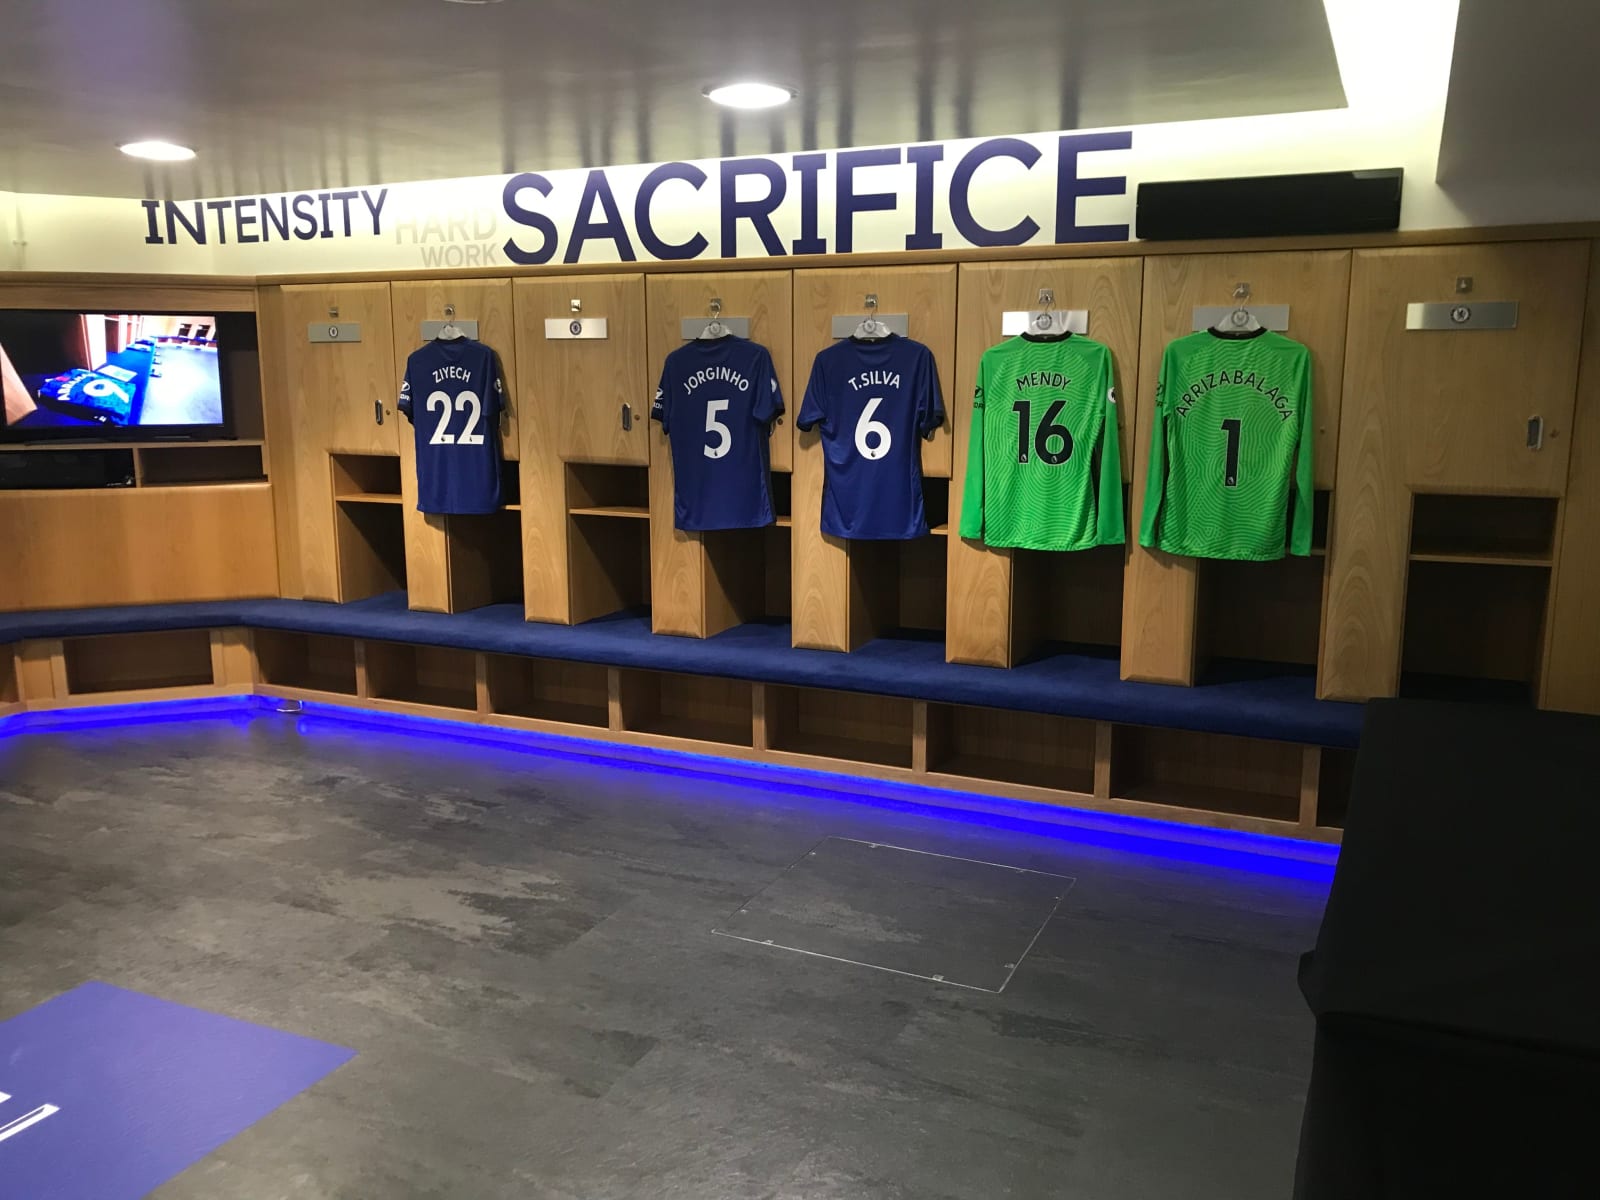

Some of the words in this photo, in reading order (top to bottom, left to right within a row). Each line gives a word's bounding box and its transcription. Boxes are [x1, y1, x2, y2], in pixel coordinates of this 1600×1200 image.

[141, 188, 389, 245] INTENSITY
[501, 130, 1134, 266] SACRIFICE
[395, 207, 497, 245] HARD
[420, 242, 498, 268] WORK
[432, 366, 471, 383] ZIYECH
[683, 366, 750, 395] JORGINHO
[848, 370, 901, 392] T.SILVA
[1016, 371, 1072, 392] MENDY
[1175, 370, 1294, 422] ARRIZABALAGA
[426, 390, 485, 445] 22
[703, 399, 732, 459] 5
[854, 397, 892, 460] 6
[1012, 400, 1074, 466] 16
[1220, 418, 1242, 487] 1
